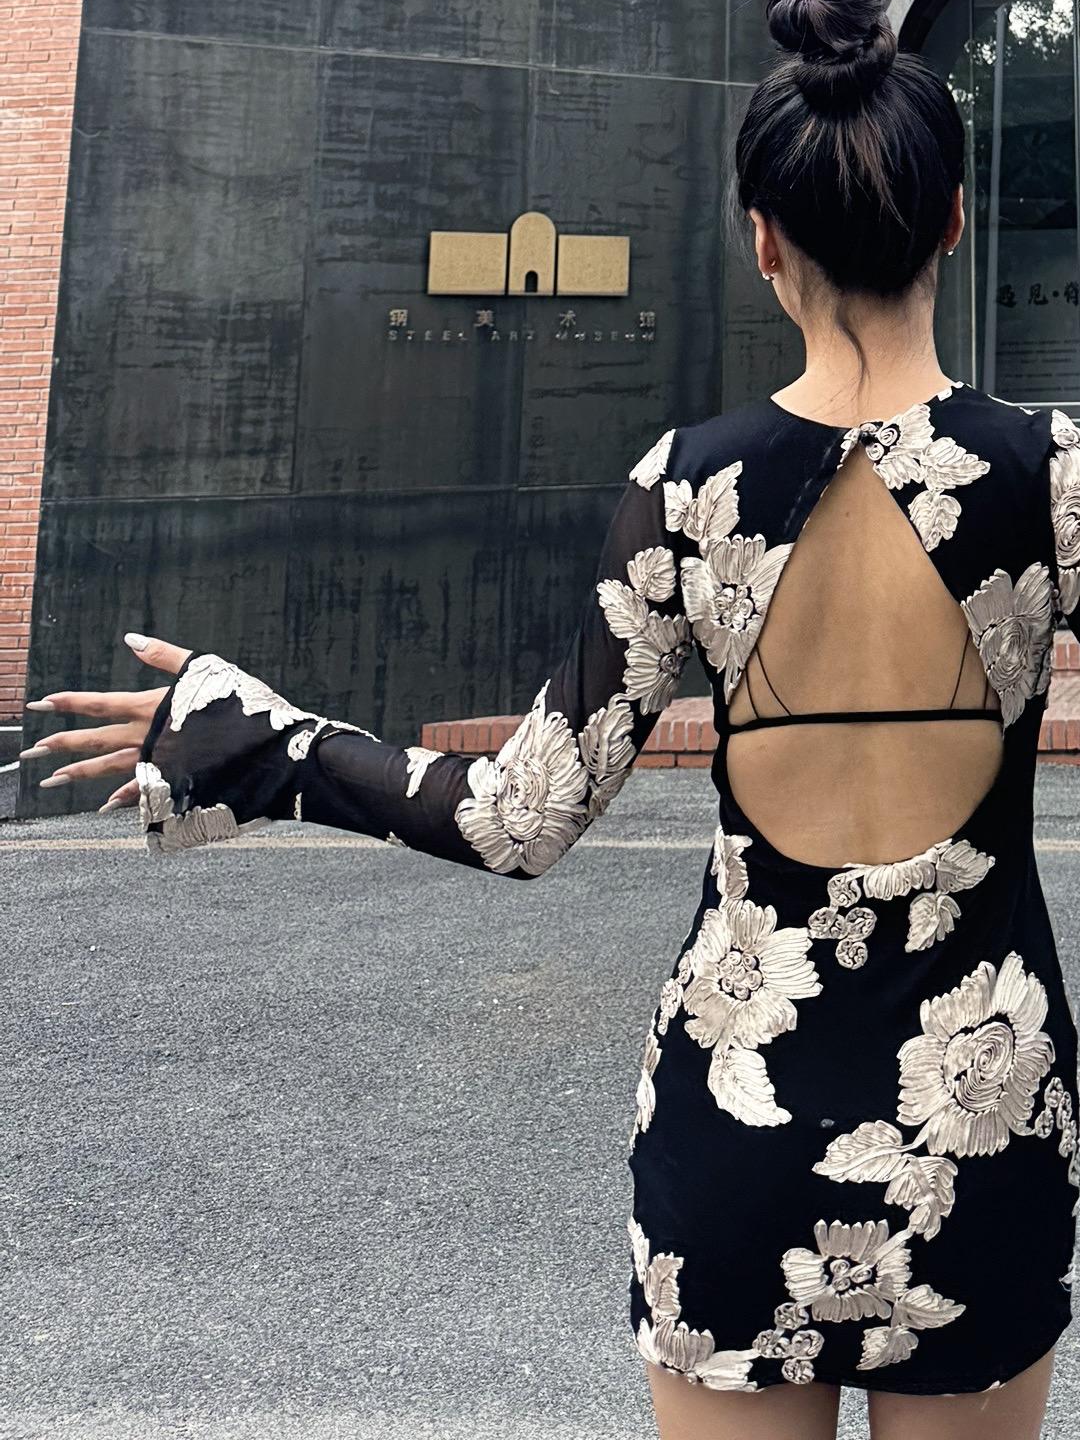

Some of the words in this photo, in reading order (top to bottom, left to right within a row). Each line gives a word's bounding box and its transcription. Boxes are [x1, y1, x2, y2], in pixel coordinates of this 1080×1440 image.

[388, 329, 468, 342] STEEL
[491, 329, 536, 342] ART
[555, 329, 655, 342] MUSEUM
